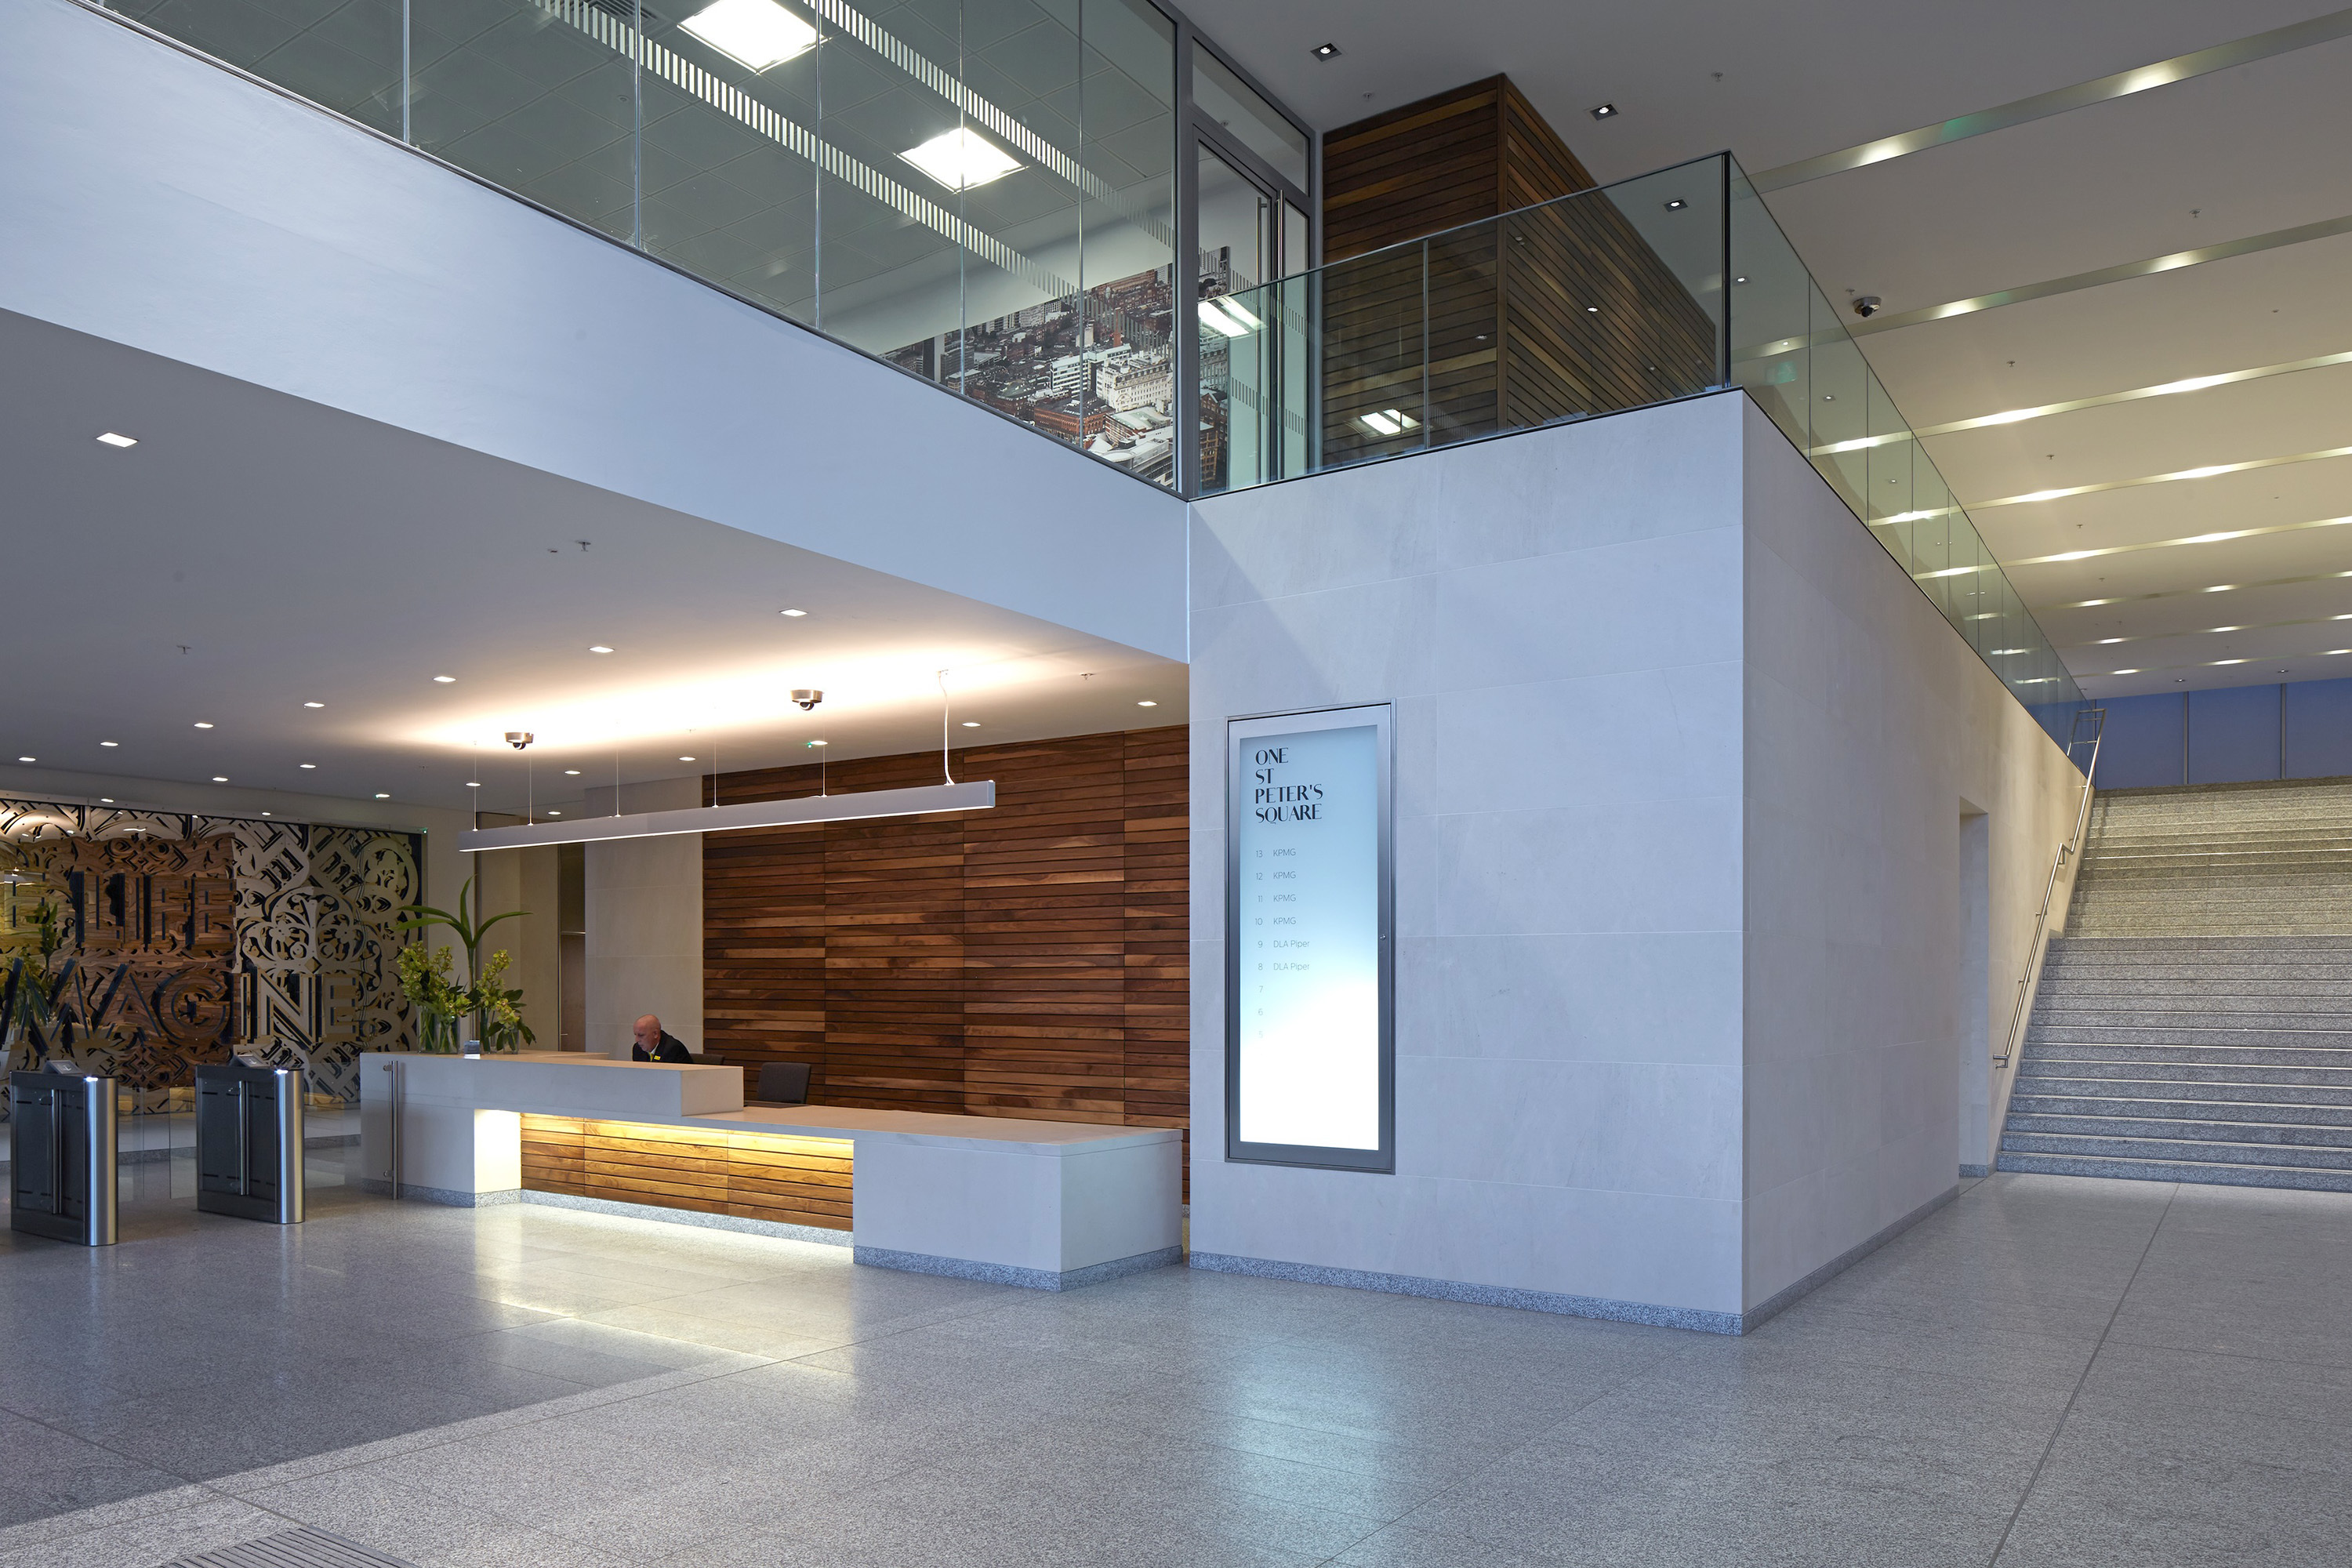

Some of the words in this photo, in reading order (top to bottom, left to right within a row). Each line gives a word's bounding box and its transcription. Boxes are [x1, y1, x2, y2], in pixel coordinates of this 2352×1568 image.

[1255, 747, 1289, 765] ONE
[1255, 768, 1275, 785] ST
[1255, 783, 1323, 804] PETER'S
[1255, 804, 1323, 824] SQUARE
[1256, 849, 1263, 858] 13
[1272, 848, 1297, 857] KPMG
[1256, 872, 1263, 880] 12
[1273, 870, 1297, 879] KPMG
[1258, 895, 1263, 903] 11
[1273, 894, 1297, 902] KPMG
[70, 871, 237, 949] LIFE
[1254, 917, 1264, 926] 10
[1273, 916, 1297, 925] KPMG
[1258, 940, 1263, 949] 9
[1290, 939, 1310, 949] Piper
[1258, 963, 1264, 971] 8
[1273, 962, 1289, 971] DLA
[1290, 962, 1310, 971] Piper
